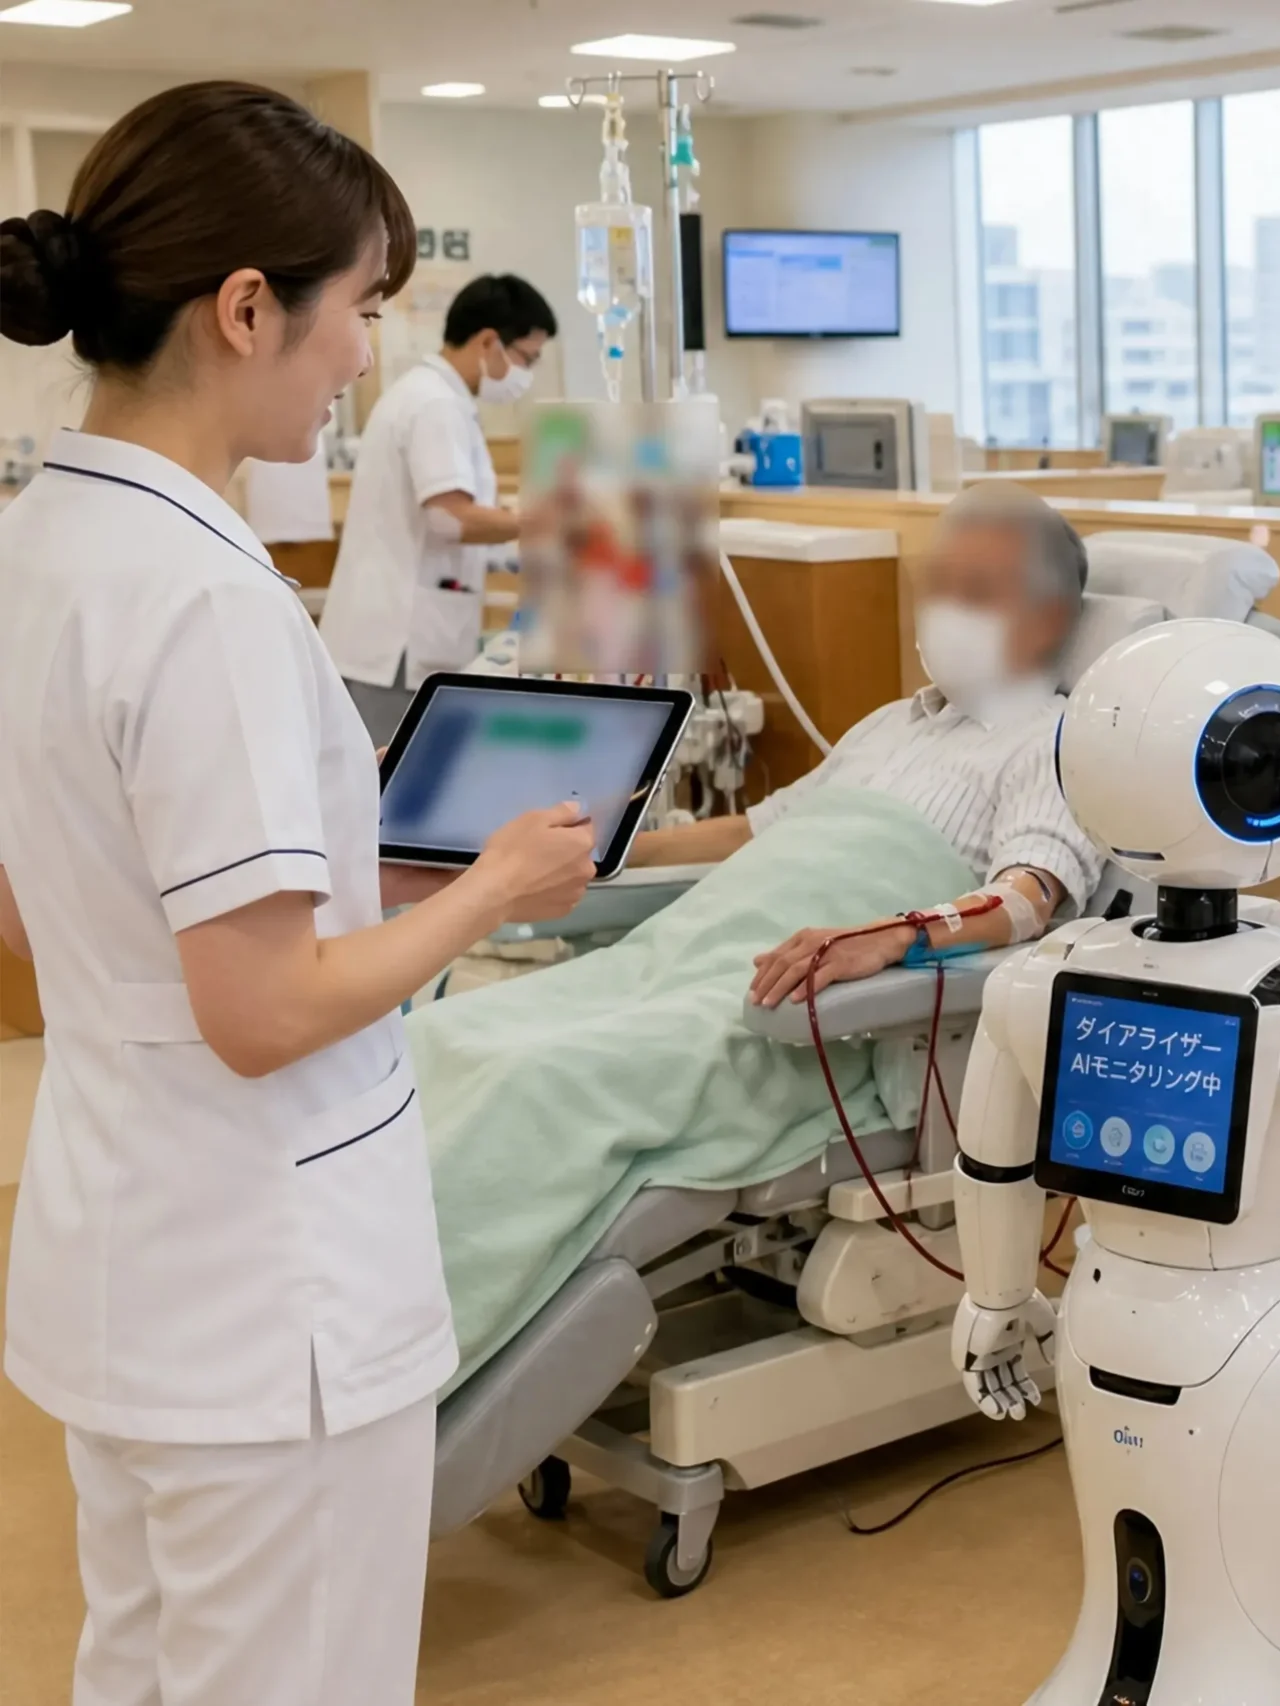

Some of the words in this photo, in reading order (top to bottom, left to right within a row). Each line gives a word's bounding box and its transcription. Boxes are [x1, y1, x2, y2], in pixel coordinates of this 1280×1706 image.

[1076, 1016, 1222, 1057] ダイアライザー
[1071, 1053, 1221, 1097] AIモニタリング中
